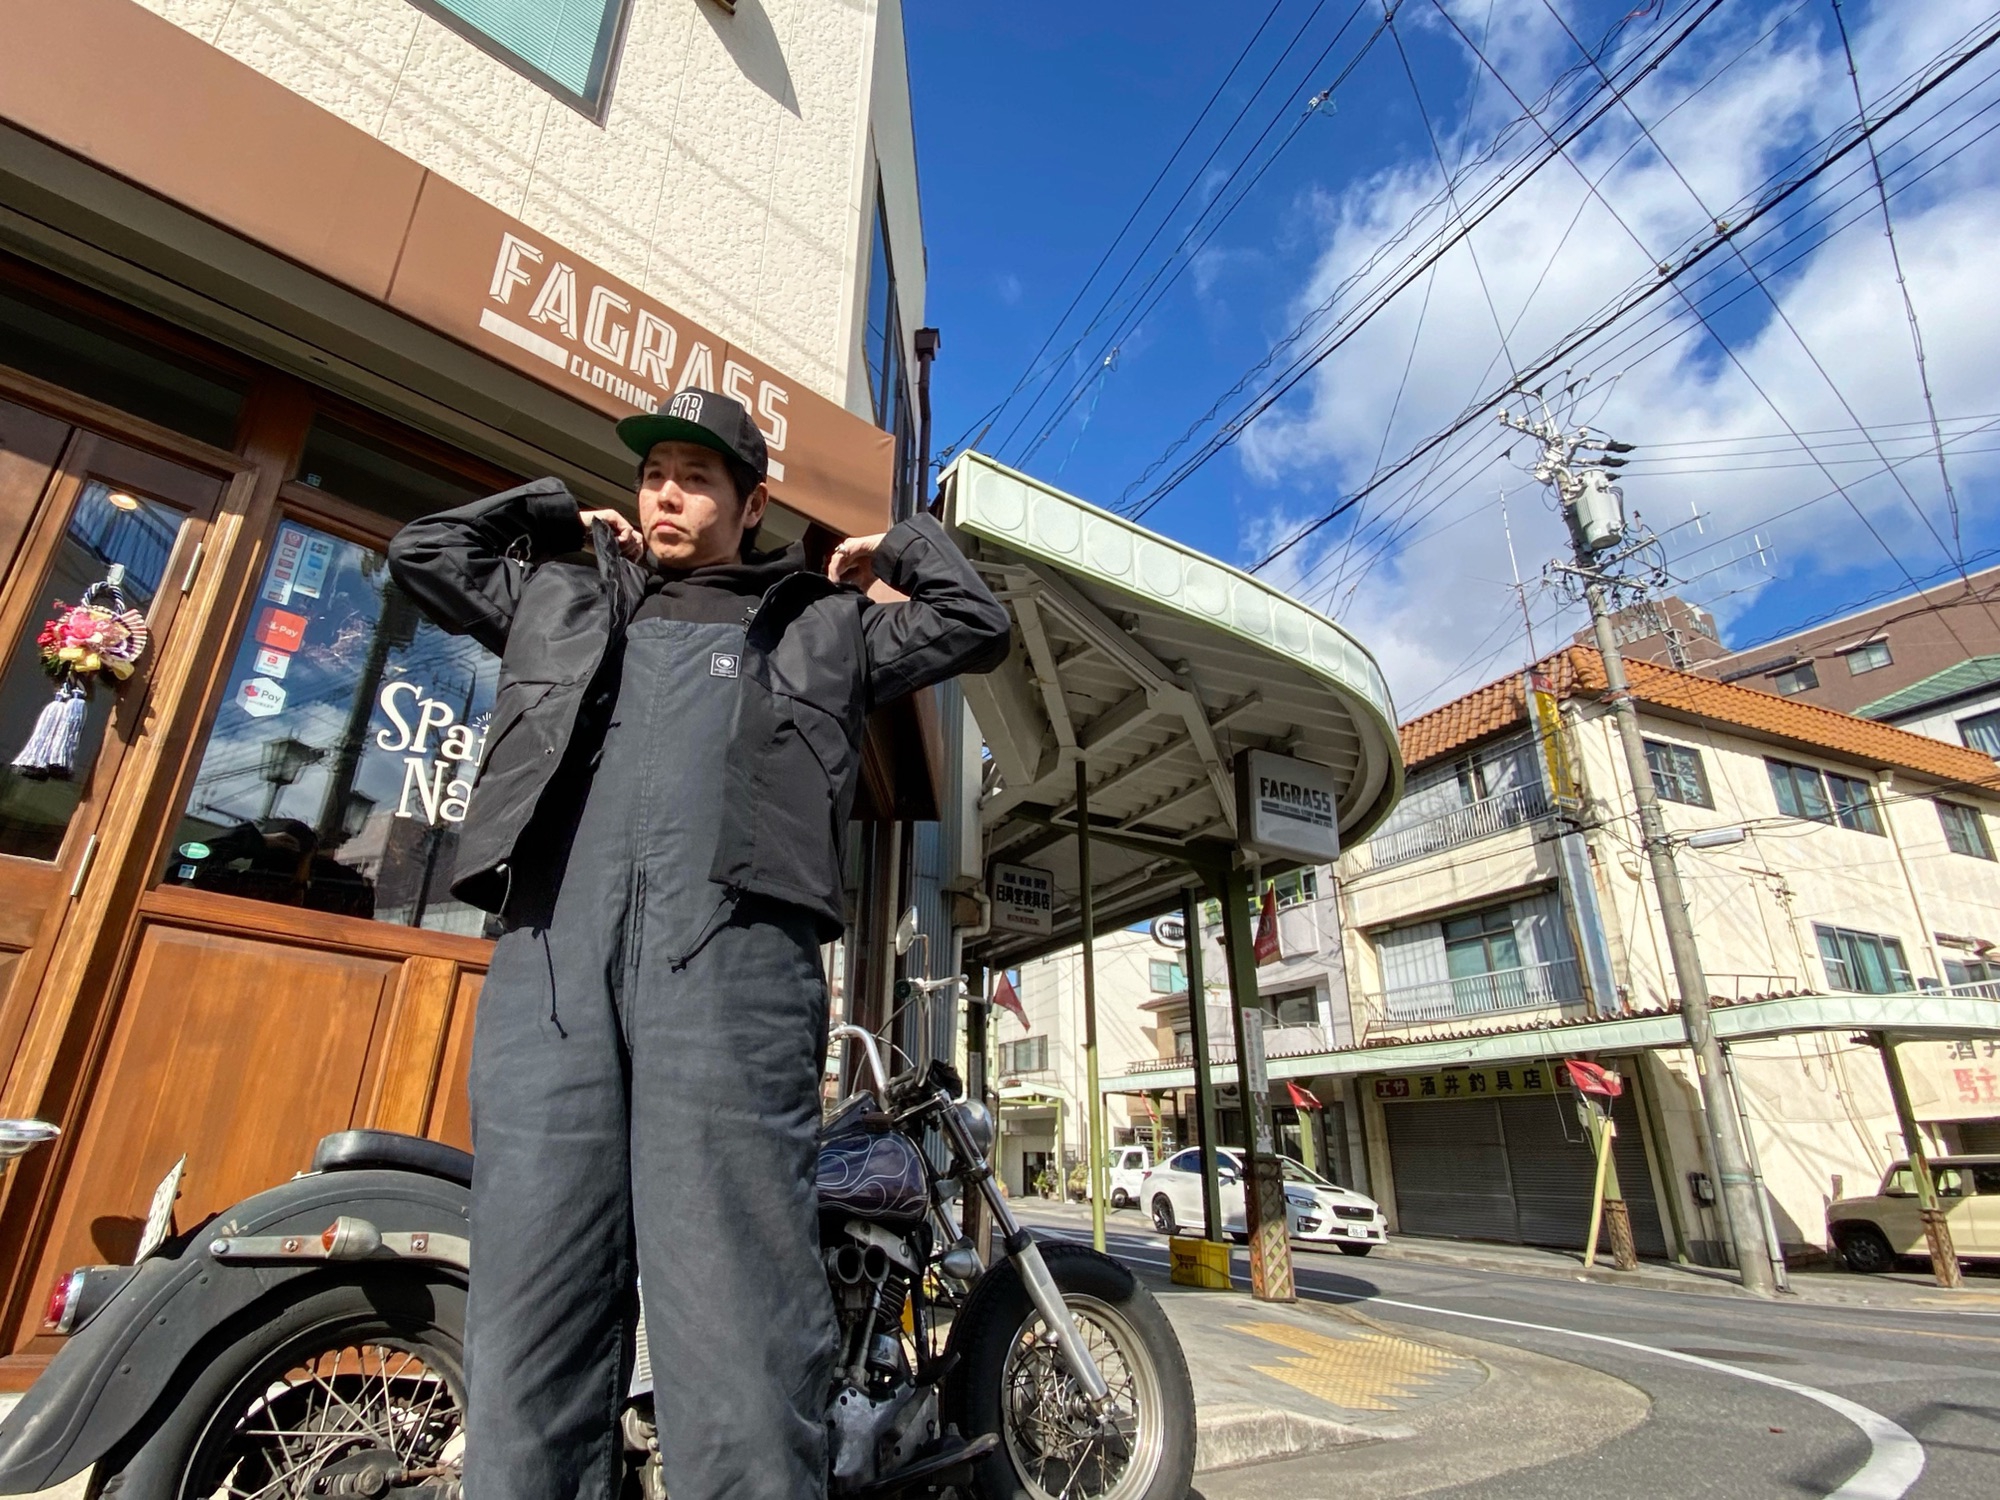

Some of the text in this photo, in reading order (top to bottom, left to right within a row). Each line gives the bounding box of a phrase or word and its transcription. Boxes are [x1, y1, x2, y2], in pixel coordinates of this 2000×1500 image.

[489, 232, 789, 452] FAGRASS
[569, 356, 660, 415] CLOTHING
[279, 626, 299, 638] Pay
[261, 690, 281, 704] Pay
[1260, 777, 1331, 813] FAGRASS
[1420, 1069, 1542, 1096] 酒井釣具店
